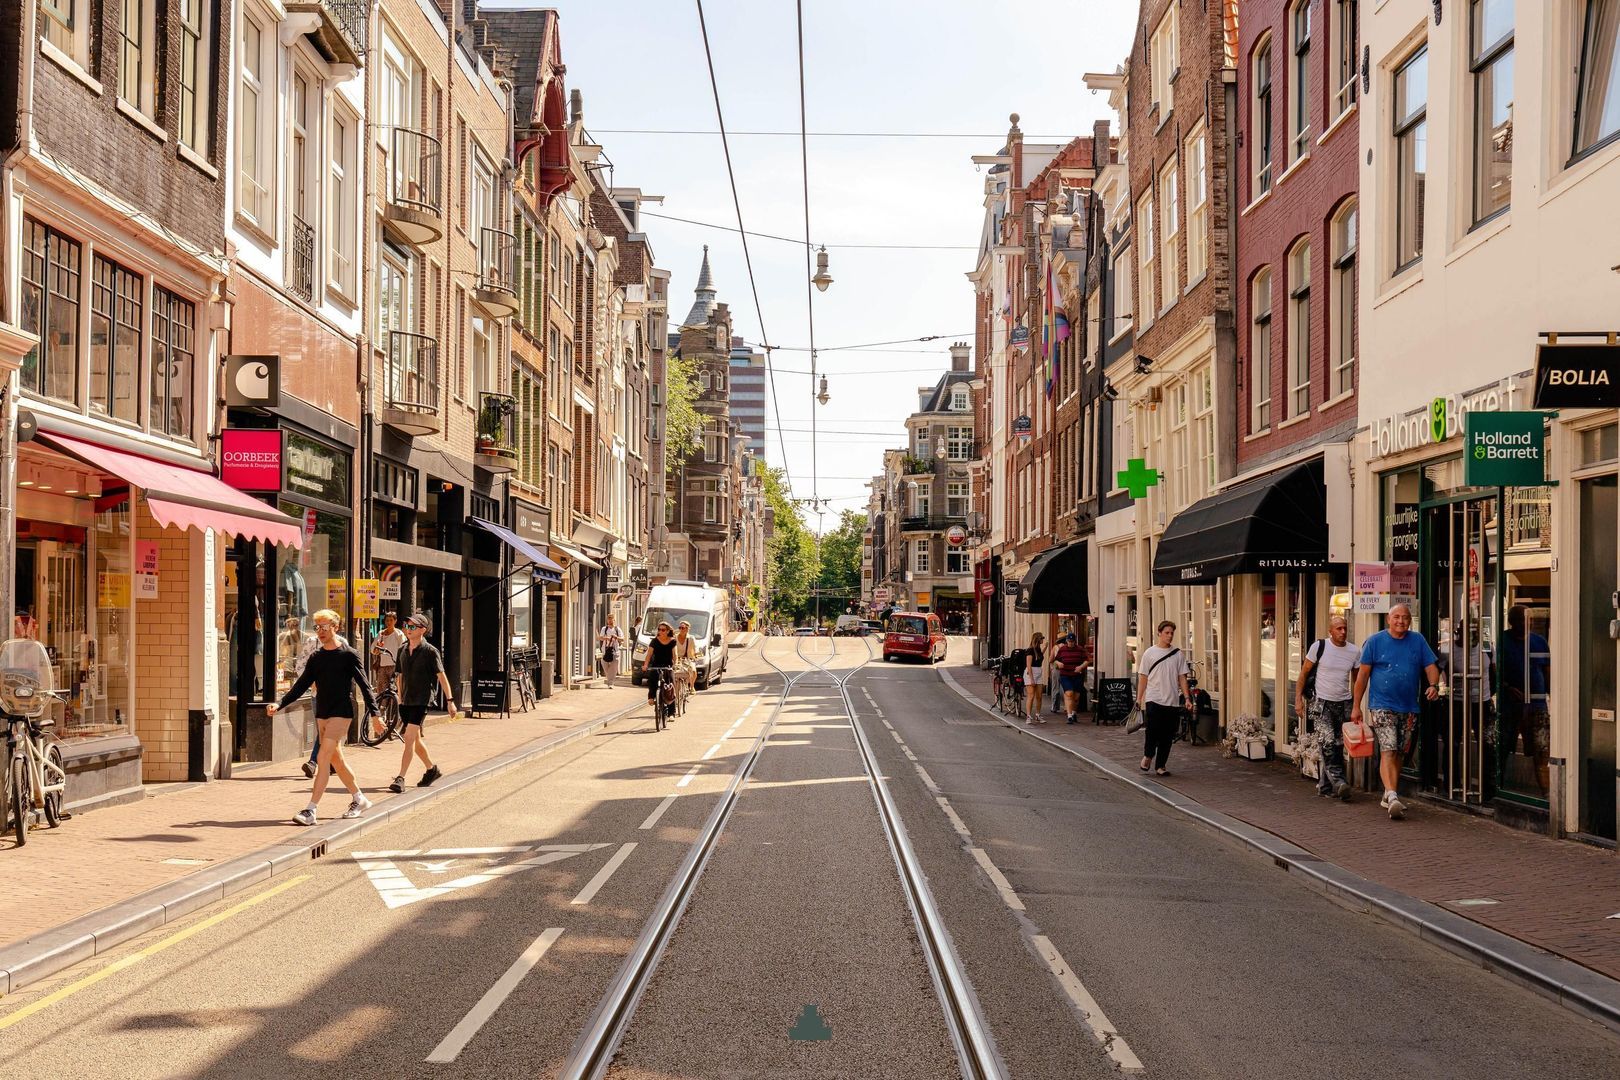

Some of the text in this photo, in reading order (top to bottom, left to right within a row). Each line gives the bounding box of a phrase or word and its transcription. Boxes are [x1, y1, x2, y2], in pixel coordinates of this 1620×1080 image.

[1549, 369, 1610, 385] BOLIA
[1369, 402, 1430, 458] Holland
[1475, 432, 1531, 445] Holland
[223, 451, 279, 463] OORBEEK
[1487, 445, 1538, 459] Barrett
[1385, 507, 1418, 528] natuurlijke
[1106, 682, 1126, 690] LUZZI
